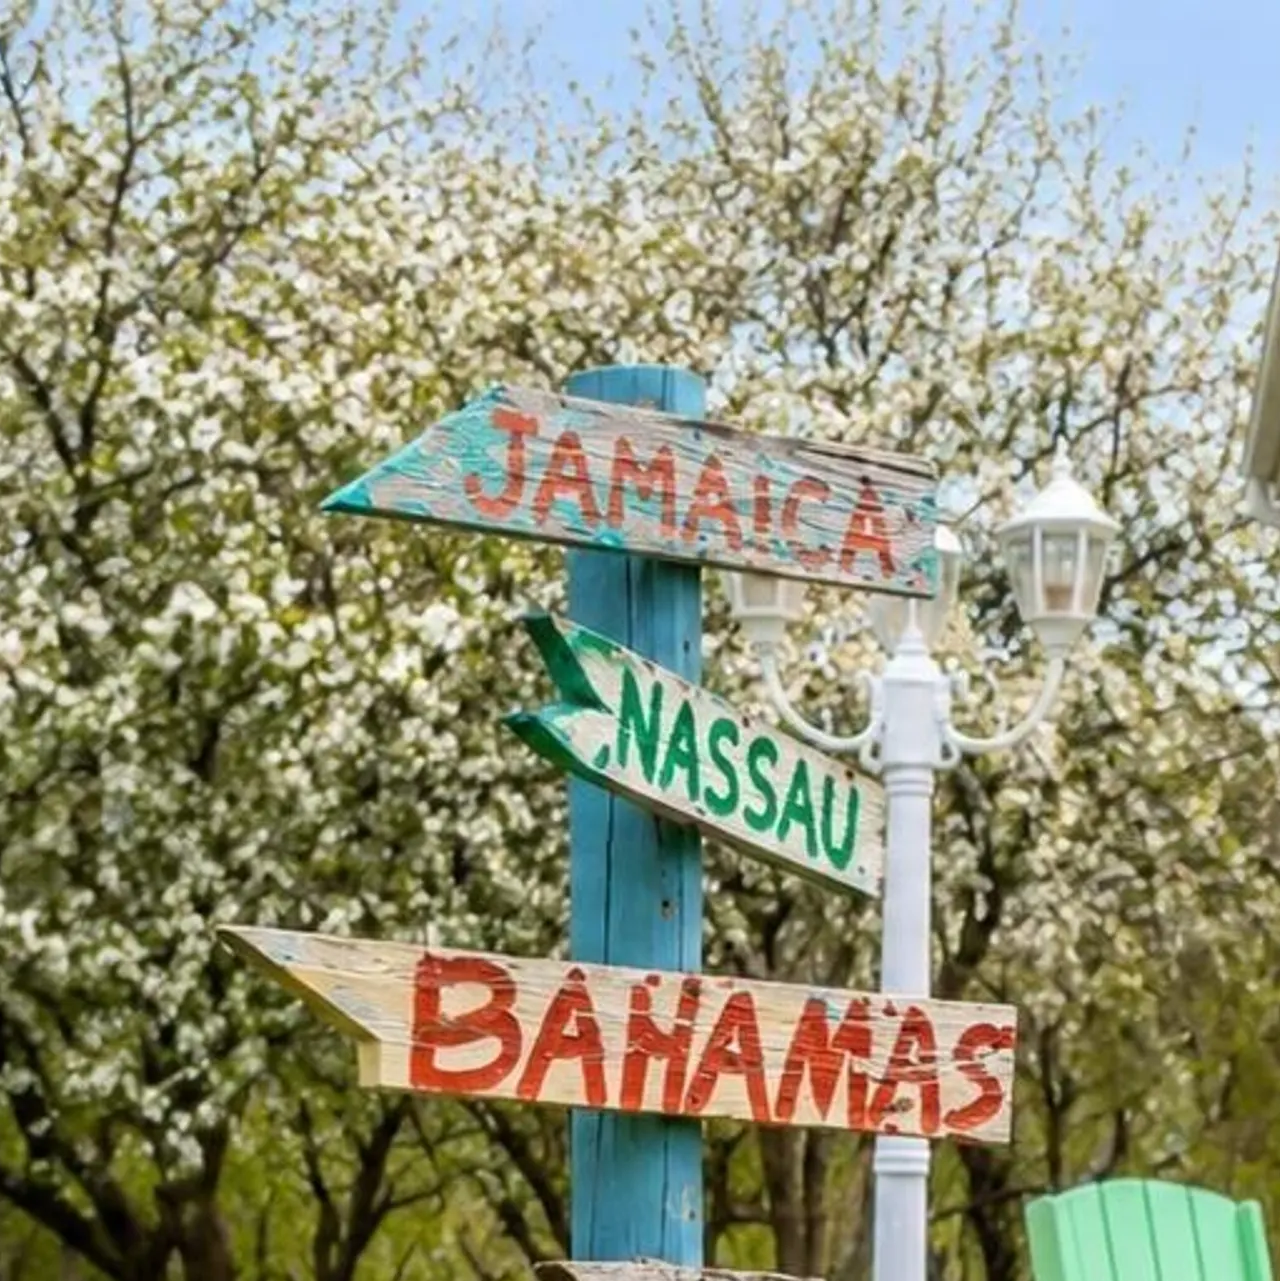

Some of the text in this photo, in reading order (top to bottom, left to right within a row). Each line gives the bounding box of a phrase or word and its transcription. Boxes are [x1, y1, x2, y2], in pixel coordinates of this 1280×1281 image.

[465, 407, 898, 579] JAMAICA
[617, 664, 860, 871] NASSAU
[408, 951, 1017, 1133] BAHAMAS
